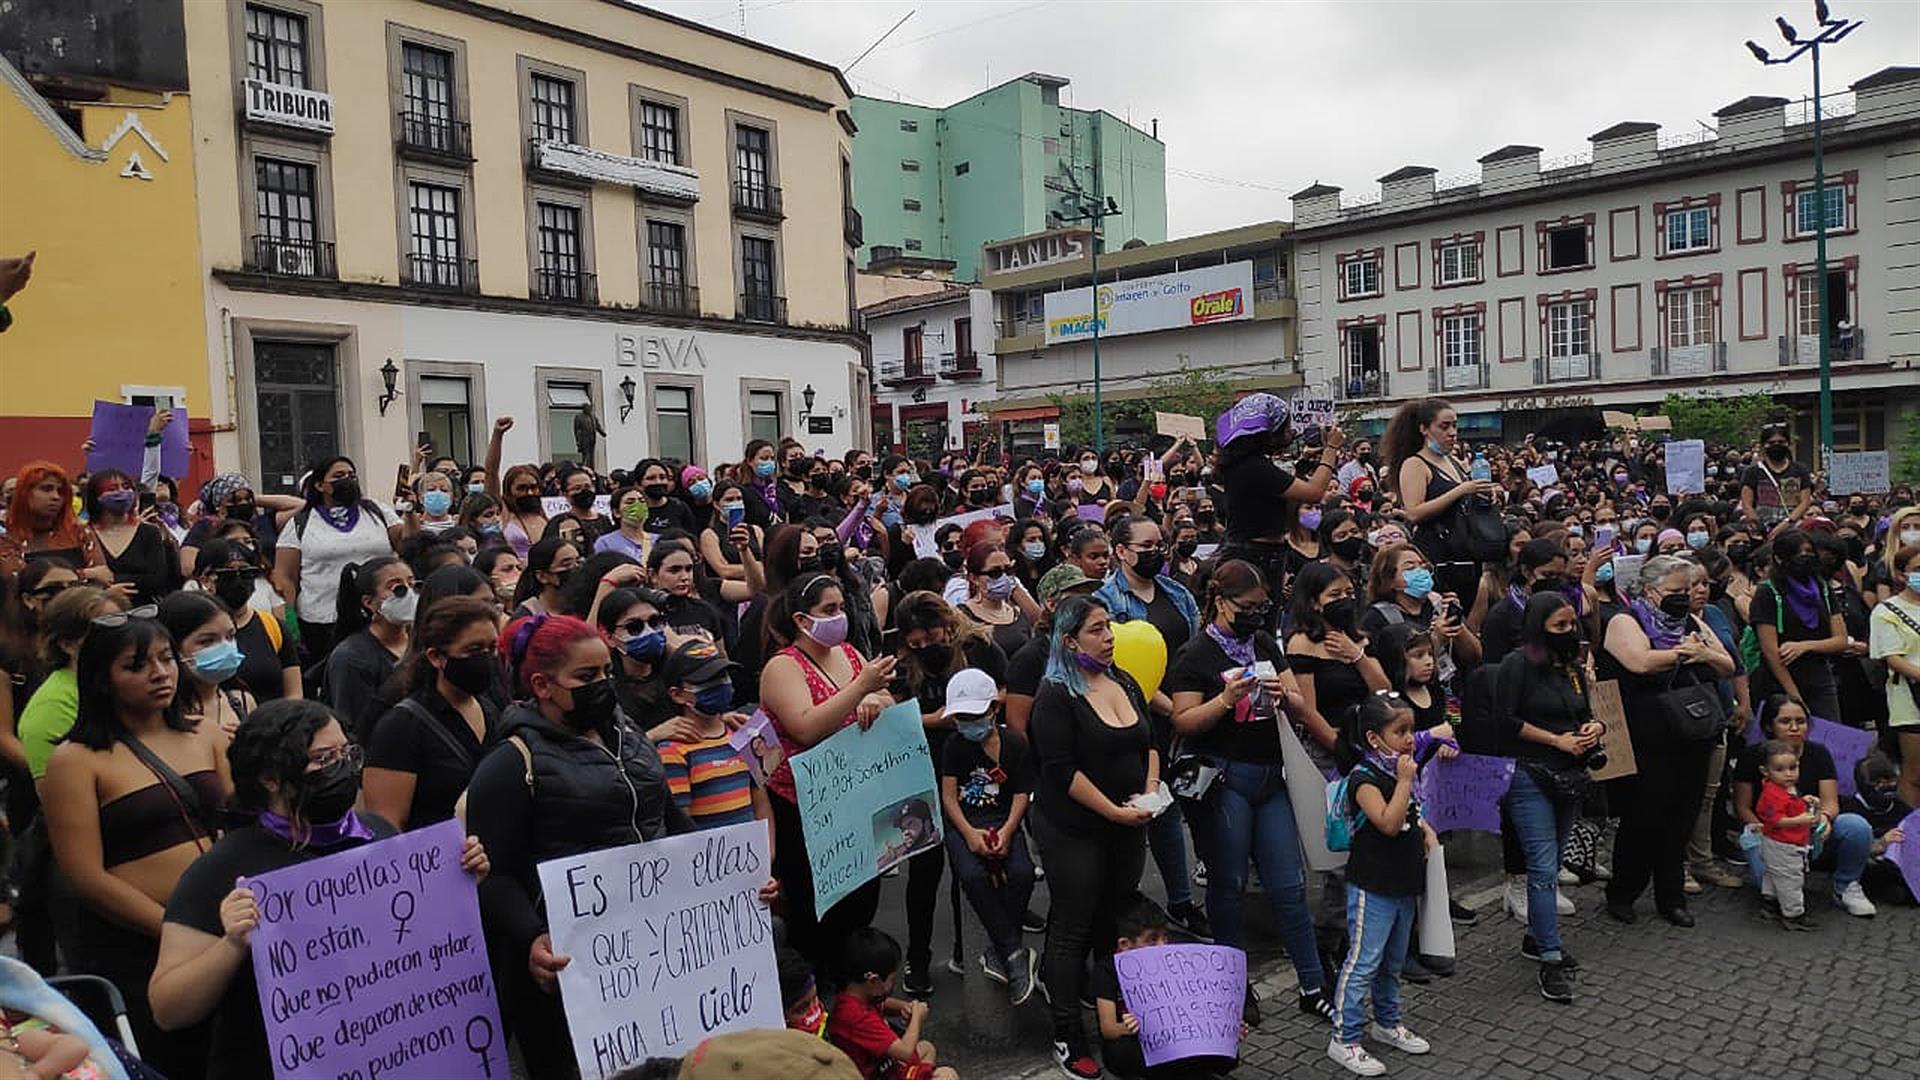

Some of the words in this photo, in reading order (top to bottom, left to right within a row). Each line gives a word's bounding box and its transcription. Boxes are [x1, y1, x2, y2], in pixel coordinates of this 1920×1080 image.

[247, 80, 331, 122] TRIBUNA
[615, 334, 707, 369] BBVA
[248, 880, 295, 924] Por
[305, 859, 401, 915] aquellas
[408, 845, 441, 894] que
[628, 857, 670, 904] POR
[692, 835, 761, 888] ellas
[592, 928, 634, 967] QUE
[662, 886, 765, 979] GRITAMOS
[270, 986, 311, 1023] Que
[315, 982, 341, 1003] no
[344, 949, 423, 1003] pudieron
[598, 961, 641, 1003] HOY
[279, 1034, 326, 1072] Que
[333, 1002, 406, 1047] dejaron
[367, 1024, 456, 1080] pudieron
[592, 1020, 649, 1080] HACIA
